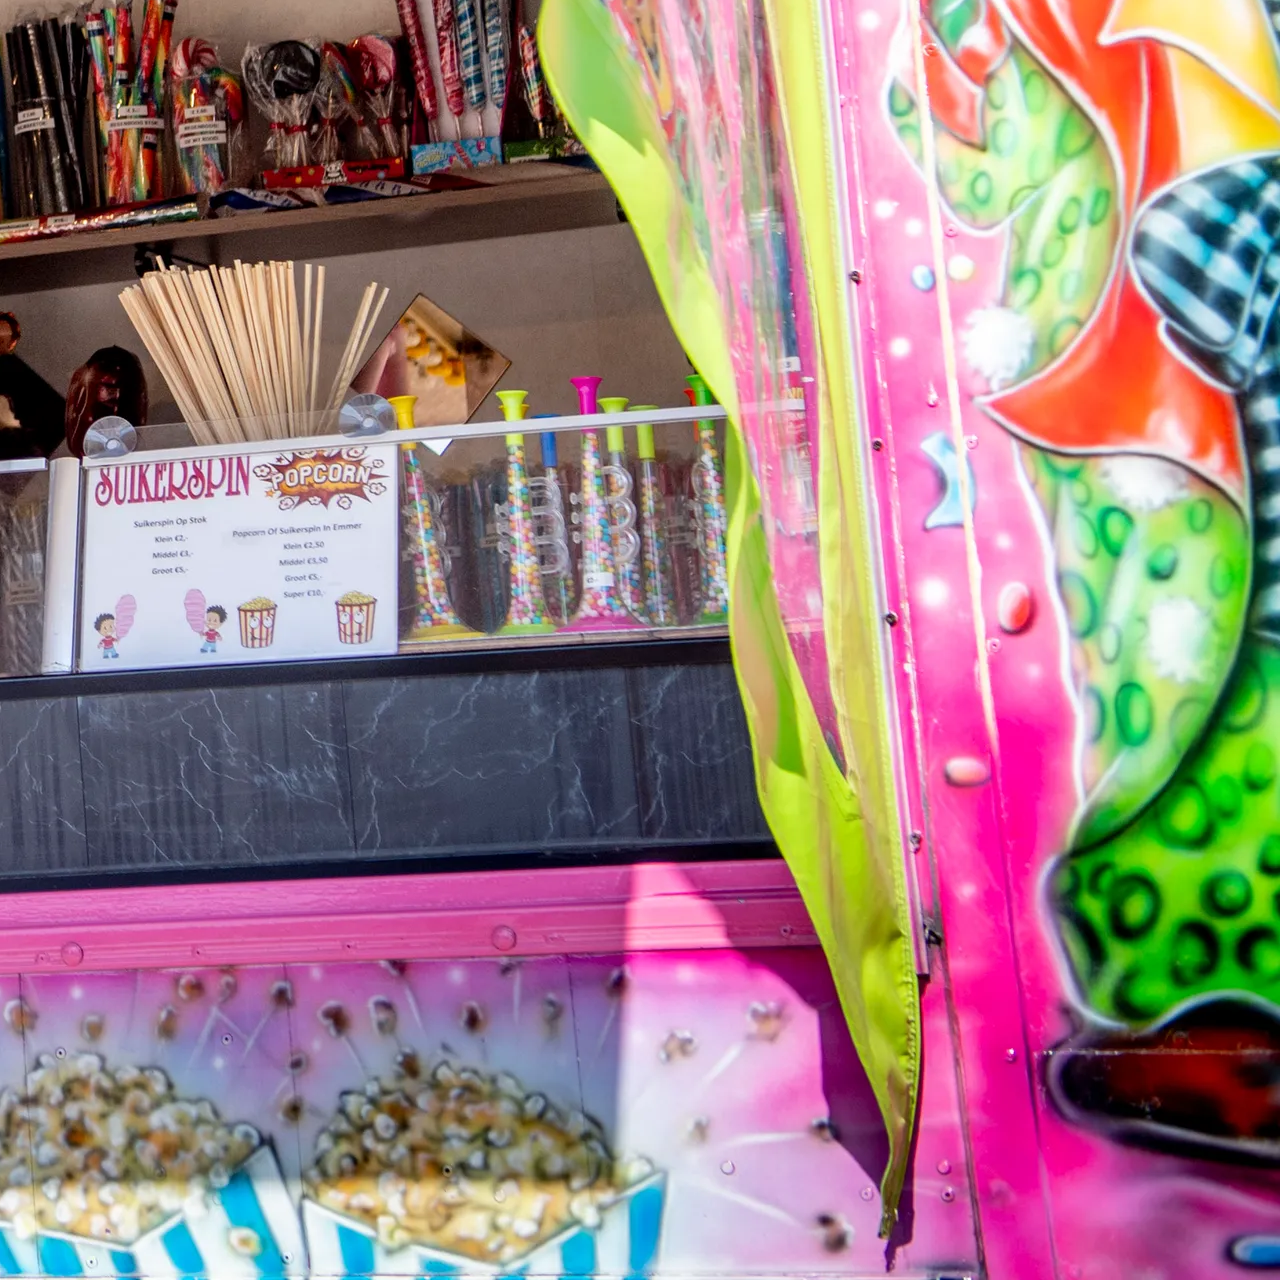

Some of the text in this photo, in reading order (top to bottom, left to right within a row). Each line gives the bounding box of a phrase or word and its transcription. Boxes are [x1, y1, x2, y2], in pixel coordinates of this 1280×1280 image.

[95, 456, 373, 507] SUIKERSPIN POPCORN
[133, 516, 208, 529] Suikerspin Op Stok
[232, 529, 266, 539] Popcorn
[267, 527, 278, 536] Of
[279, 524, 321, 536] Suikerspin
[333, 522, 363, 531] Emmer
[154, 535, 173, 544] Klein
[283, 542, 302, 551] Klein
[152, 551, 178, 560] Middel
[279, 558, 306, 567] Middel
[152, 567, 173, 575] Groot
[284, 574, 307, 583] Groot
[283, 590, 305, 600] Super
